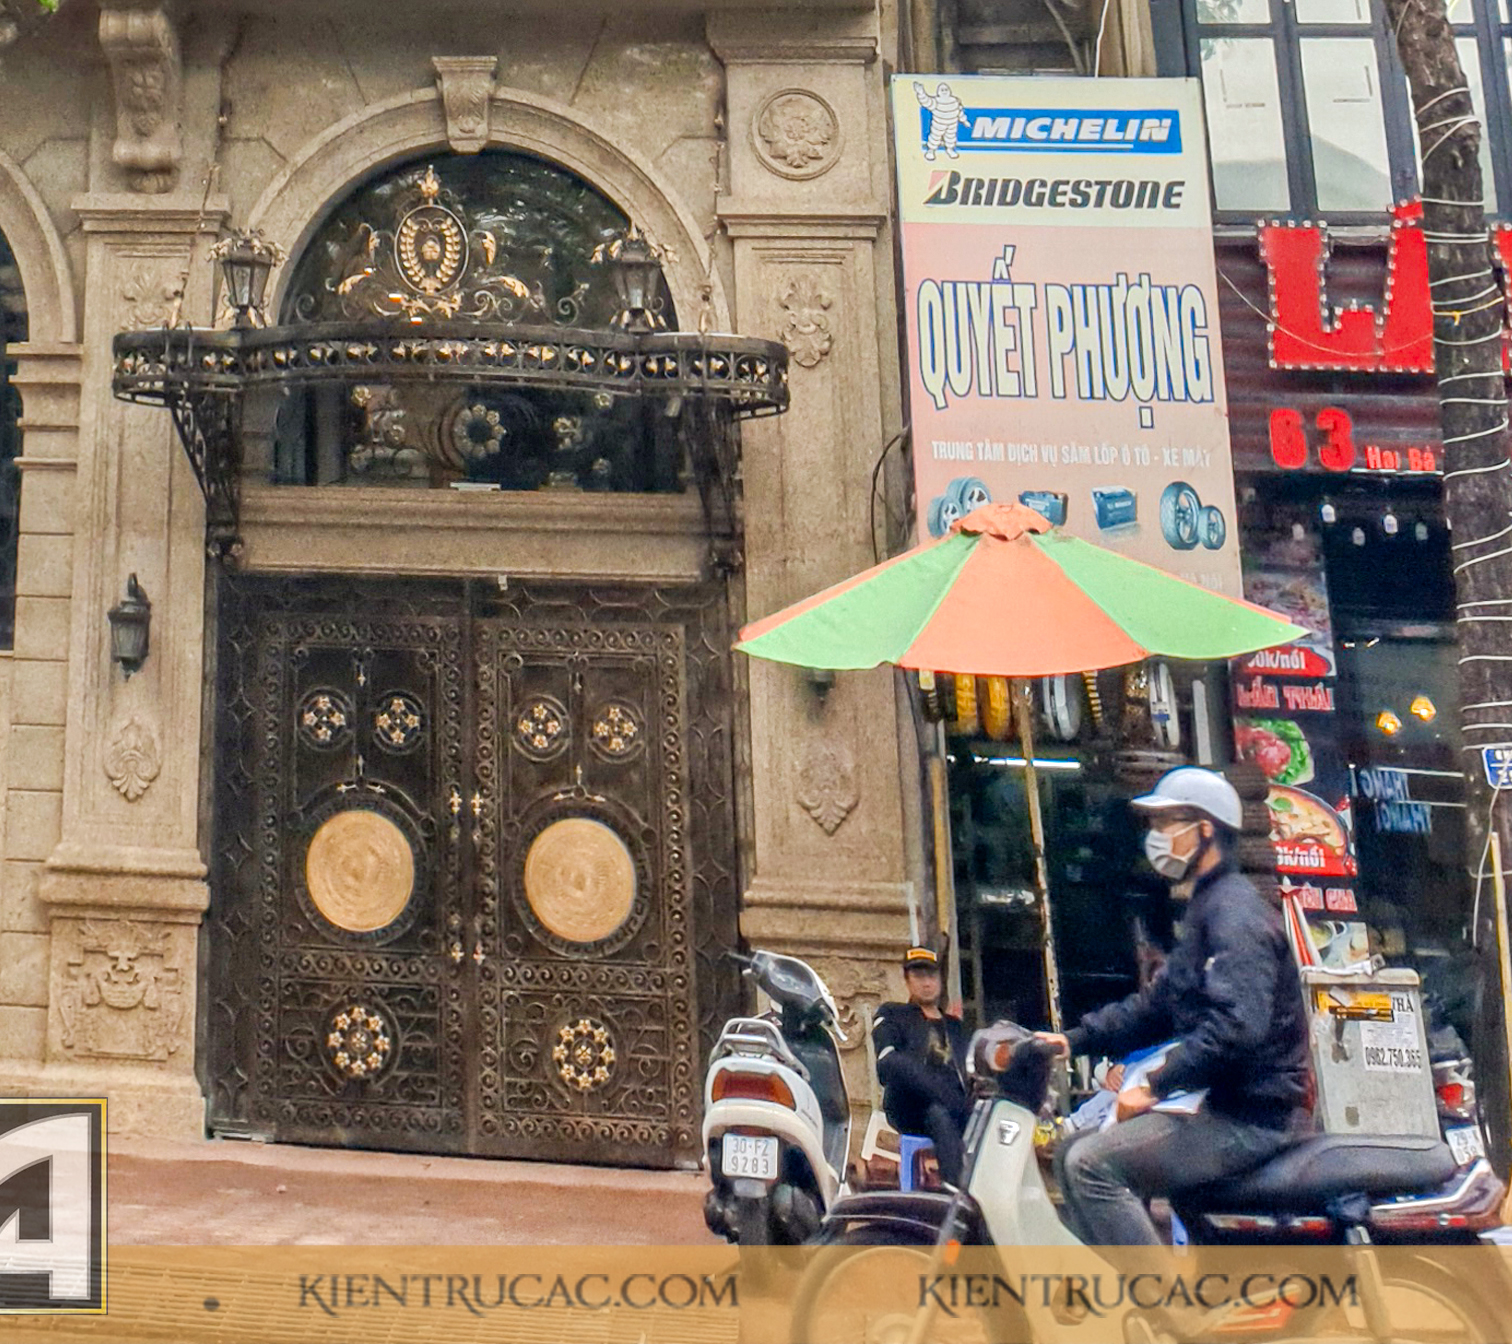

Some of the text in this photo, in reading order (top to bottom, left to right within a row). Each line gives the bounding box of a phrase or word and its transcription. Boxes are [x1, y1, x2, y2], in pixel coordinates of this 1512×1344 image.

[971, 116, 1172, 142] MICHELIN
[922, 169, 1186, 209] BRIDGESTONE
[917, 244, 1039, 411] QUYẾT
[1044, 272, 1215, 429] PHƯỢNG
[931, 439, 974, 461] TRUNG
[1269, 407, 1356, 472] 63
